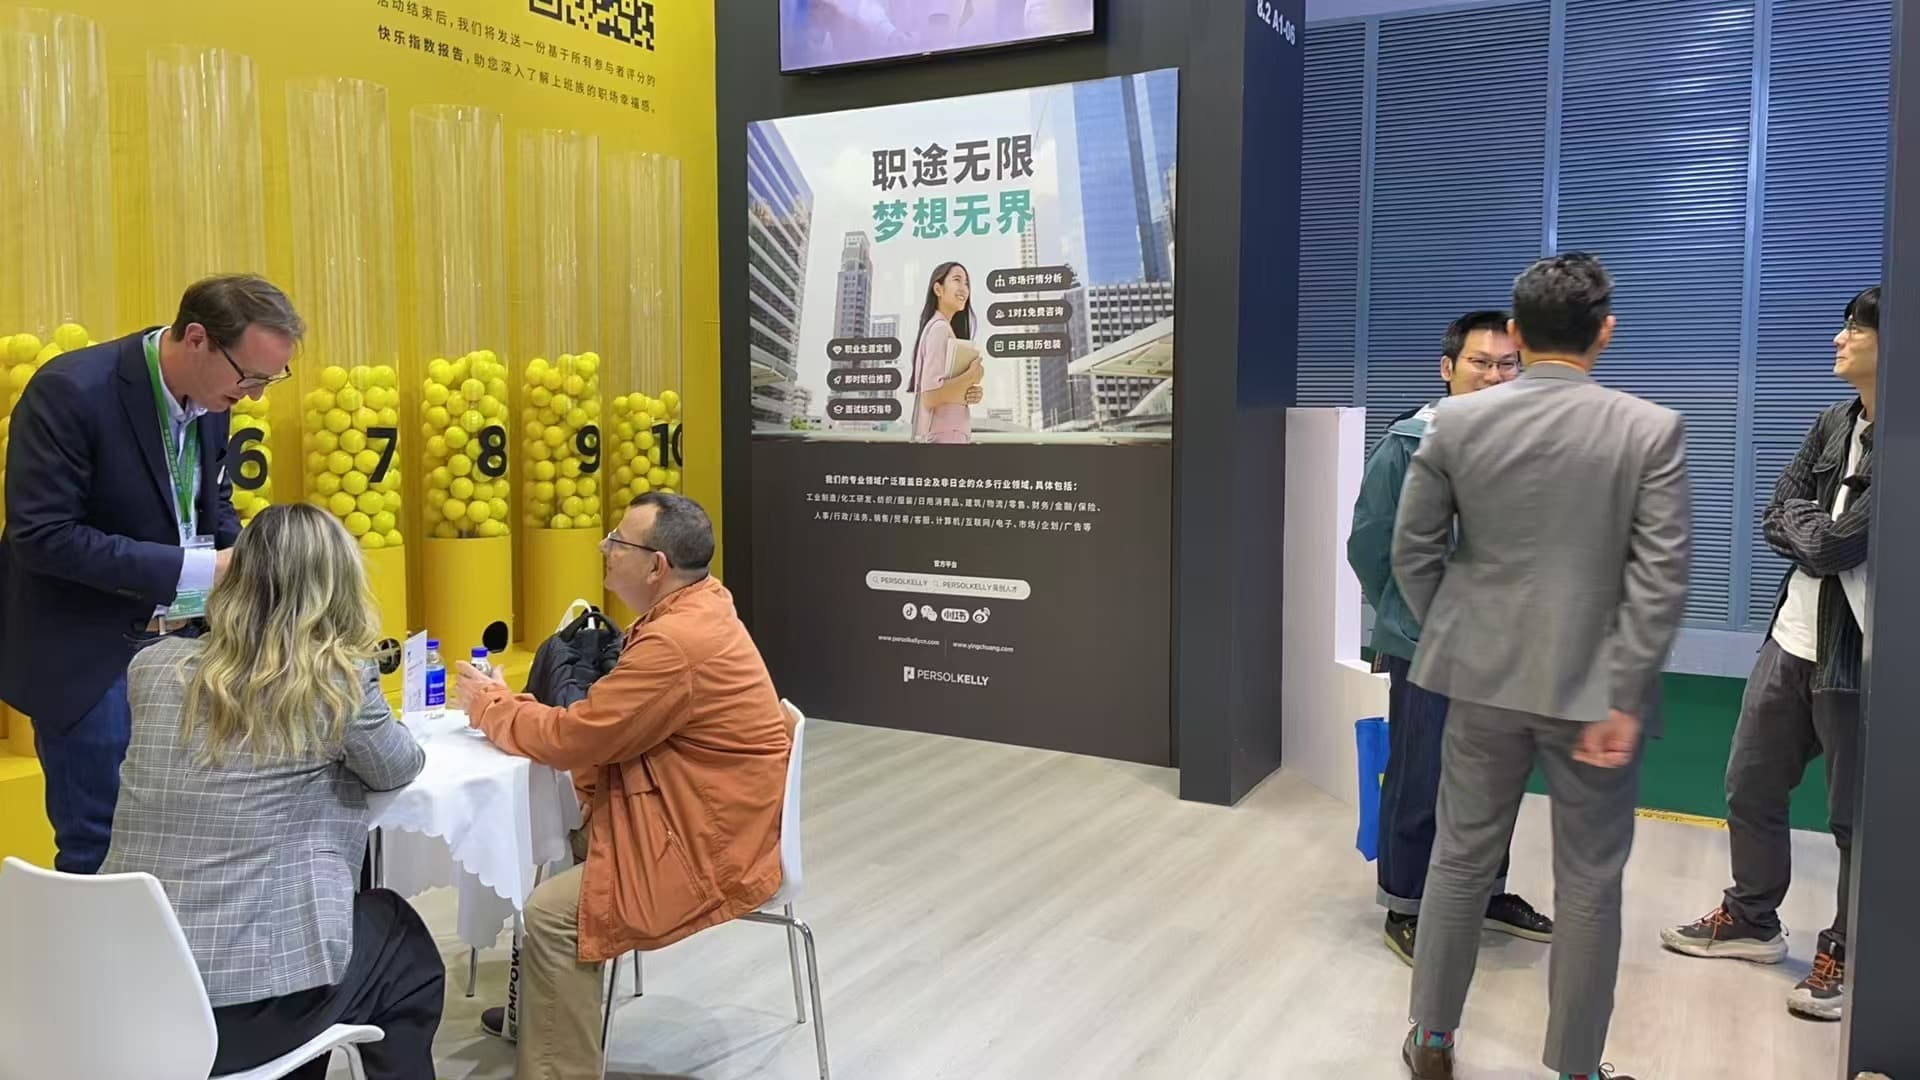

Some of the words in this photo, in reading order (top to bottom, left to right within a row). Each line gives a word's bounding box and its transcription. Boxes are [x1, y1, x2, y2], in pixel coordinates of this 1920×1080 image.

[1272, 9, 1296, 46] A1-06
[872, 134, 1034, 192] 职途无限
[872, 189, 1034, 243] 梦想无界
[1008, 273, 1063, 286] 市场行情分析
[1008, 306, 1064, 319] 1对1免费咨询
[1008, 339, 1061, 351] 日英简历包装
[228, 428, 268, 490] 6
[366, 427, 398, 483] 7
[477, 425, 507, 478] 8
[575, 425, 600, 474] 9
[880, 576, 928, 586] PERSOLKELLY
[917, 668, 989, 686] PERSOLKELLY
[508, 935, 520, 1023] EMPOW
